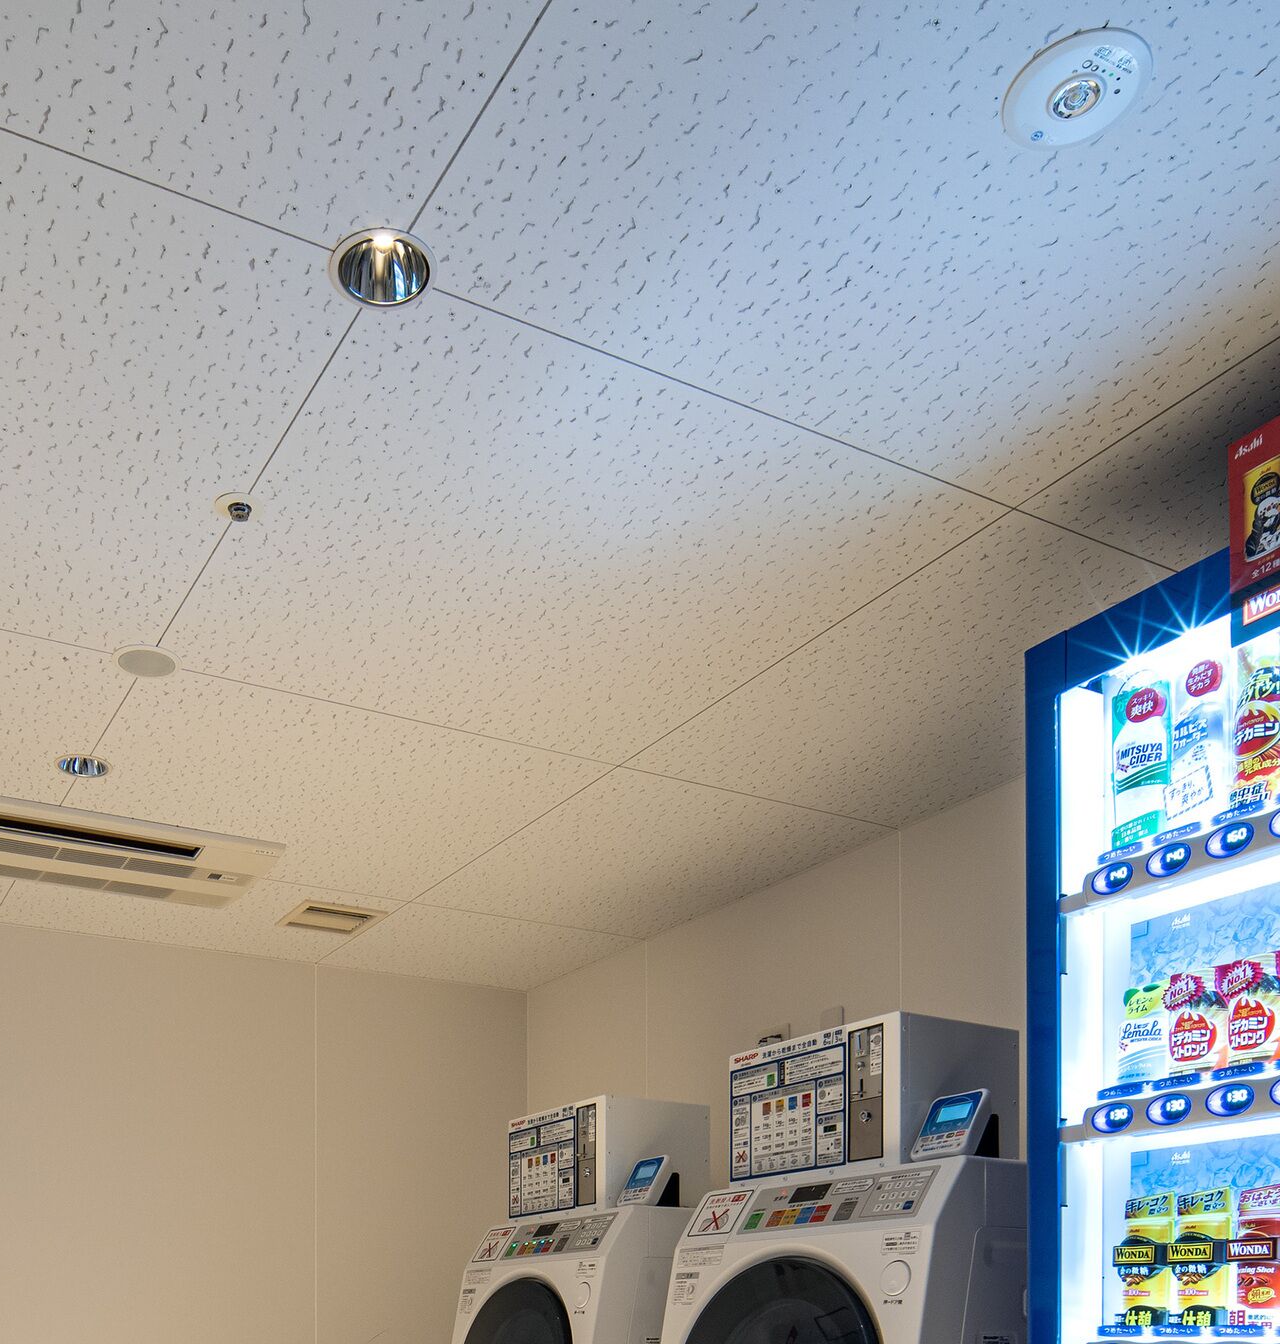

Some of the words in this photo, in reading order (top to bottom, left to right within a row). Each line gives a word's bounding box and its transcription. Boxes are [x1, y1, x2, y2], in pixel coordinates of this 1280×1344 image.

[1234, 433, 1265, 460] Asahi
[1119, 742, 1164, 761] MITSUYA
[1128, 752, 1163, 767] CIDER
[1226, 967, 1250, 989] No.1
[1168, 982, 1192, 1001] No.1
[733, 1052, 759, 1065] SHARP
[1115, 1248, 1152, 1260] WONDA
[1169, 1245, 1209, 1258] WONDA
[1228, 1243, 1270, 1256] WONDA
